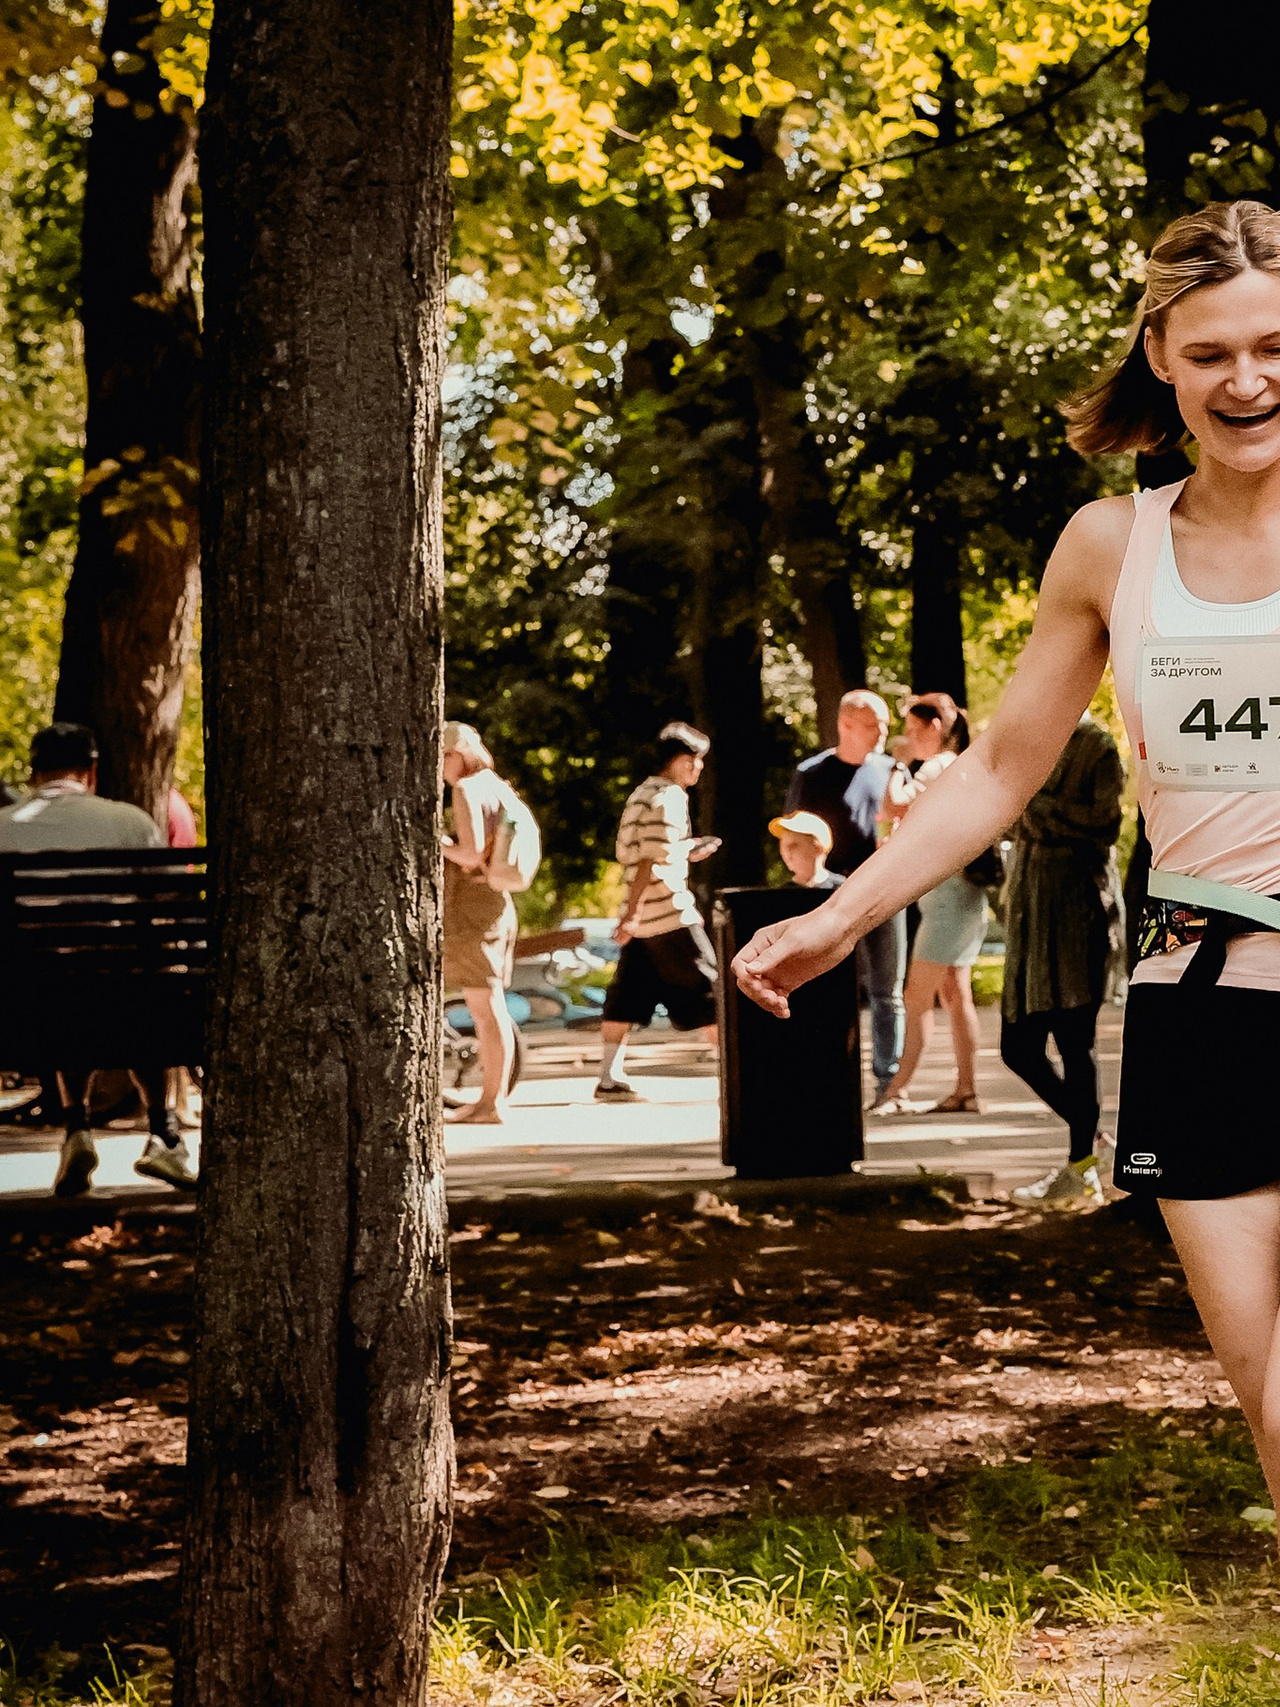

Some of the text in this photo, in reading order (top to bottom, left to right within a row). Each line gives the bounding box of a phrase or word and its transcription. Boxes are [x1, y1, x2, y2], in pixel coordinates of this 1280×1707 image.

[1151, 657, 1181, 666] БЕГИ
[1150, 667, 1222, 678] ЗА ДРУГОМ
[1123, 1165, 1163, 1178] Kalenji
